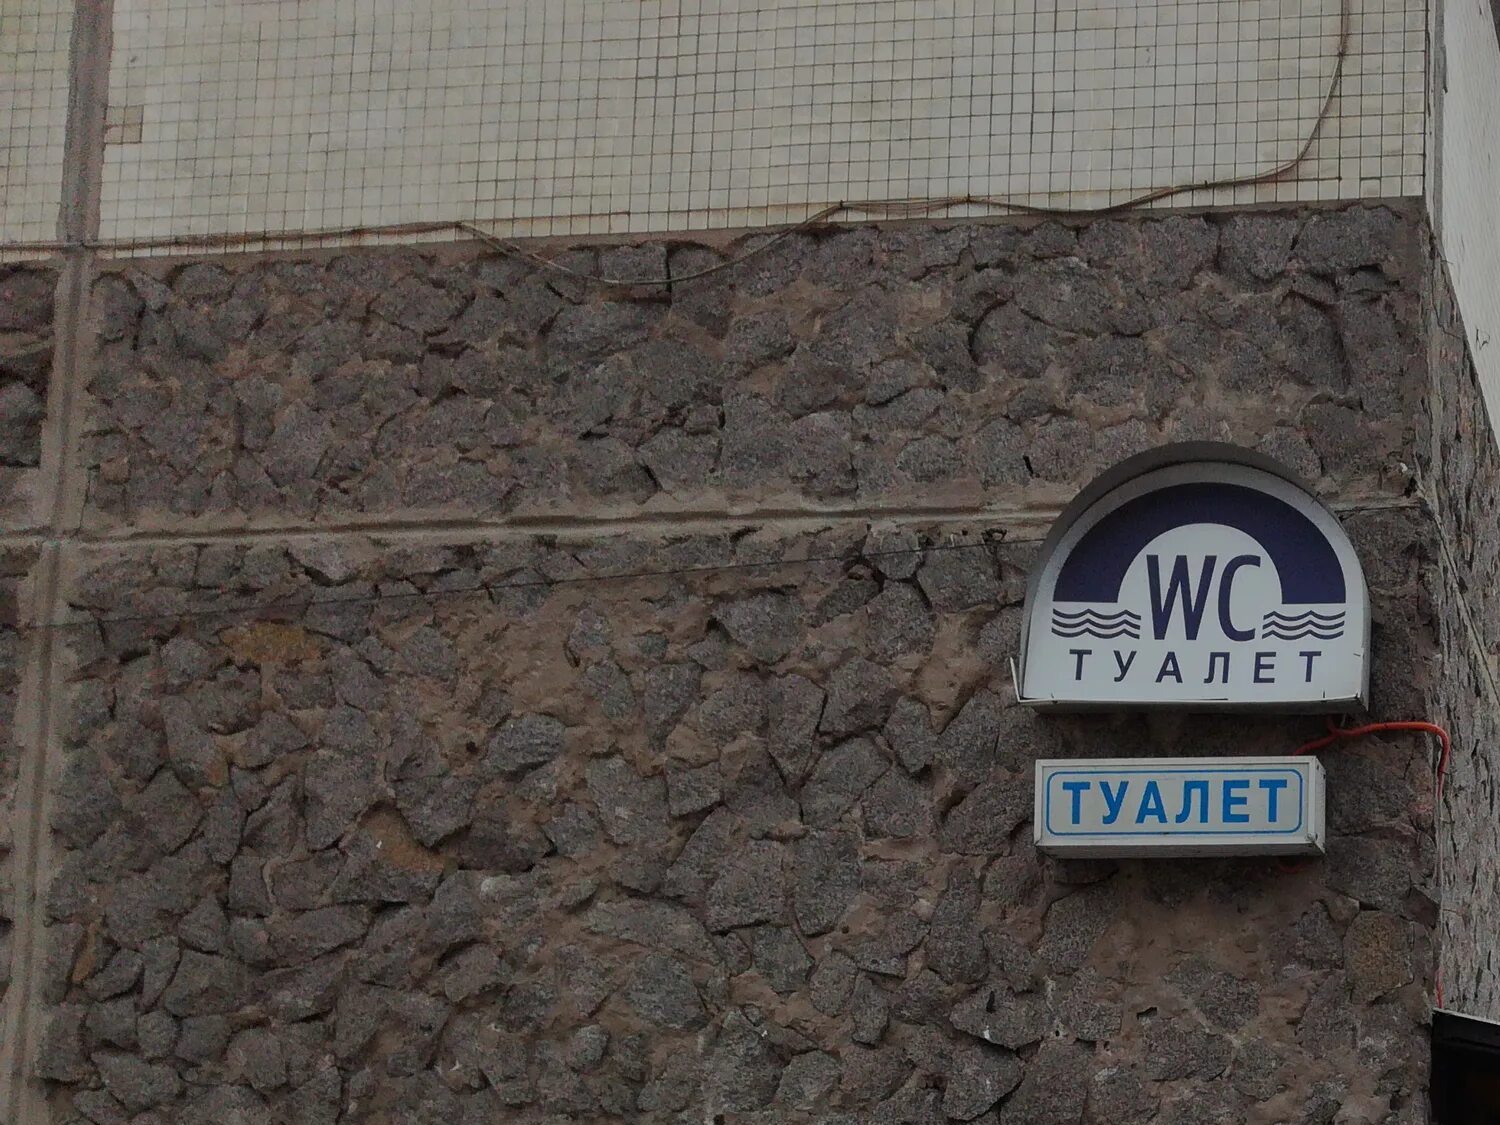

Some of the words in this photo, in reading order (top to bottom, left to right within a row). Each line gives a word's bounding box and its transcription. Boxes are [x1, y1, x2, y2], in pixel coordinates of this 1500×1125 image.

[1146, 554, 1261, 641] WC
[1069, 649, 1321, 684] ТУАЛЕТ
[1062, 779, 1287, 825] ТУАЛЕТ
